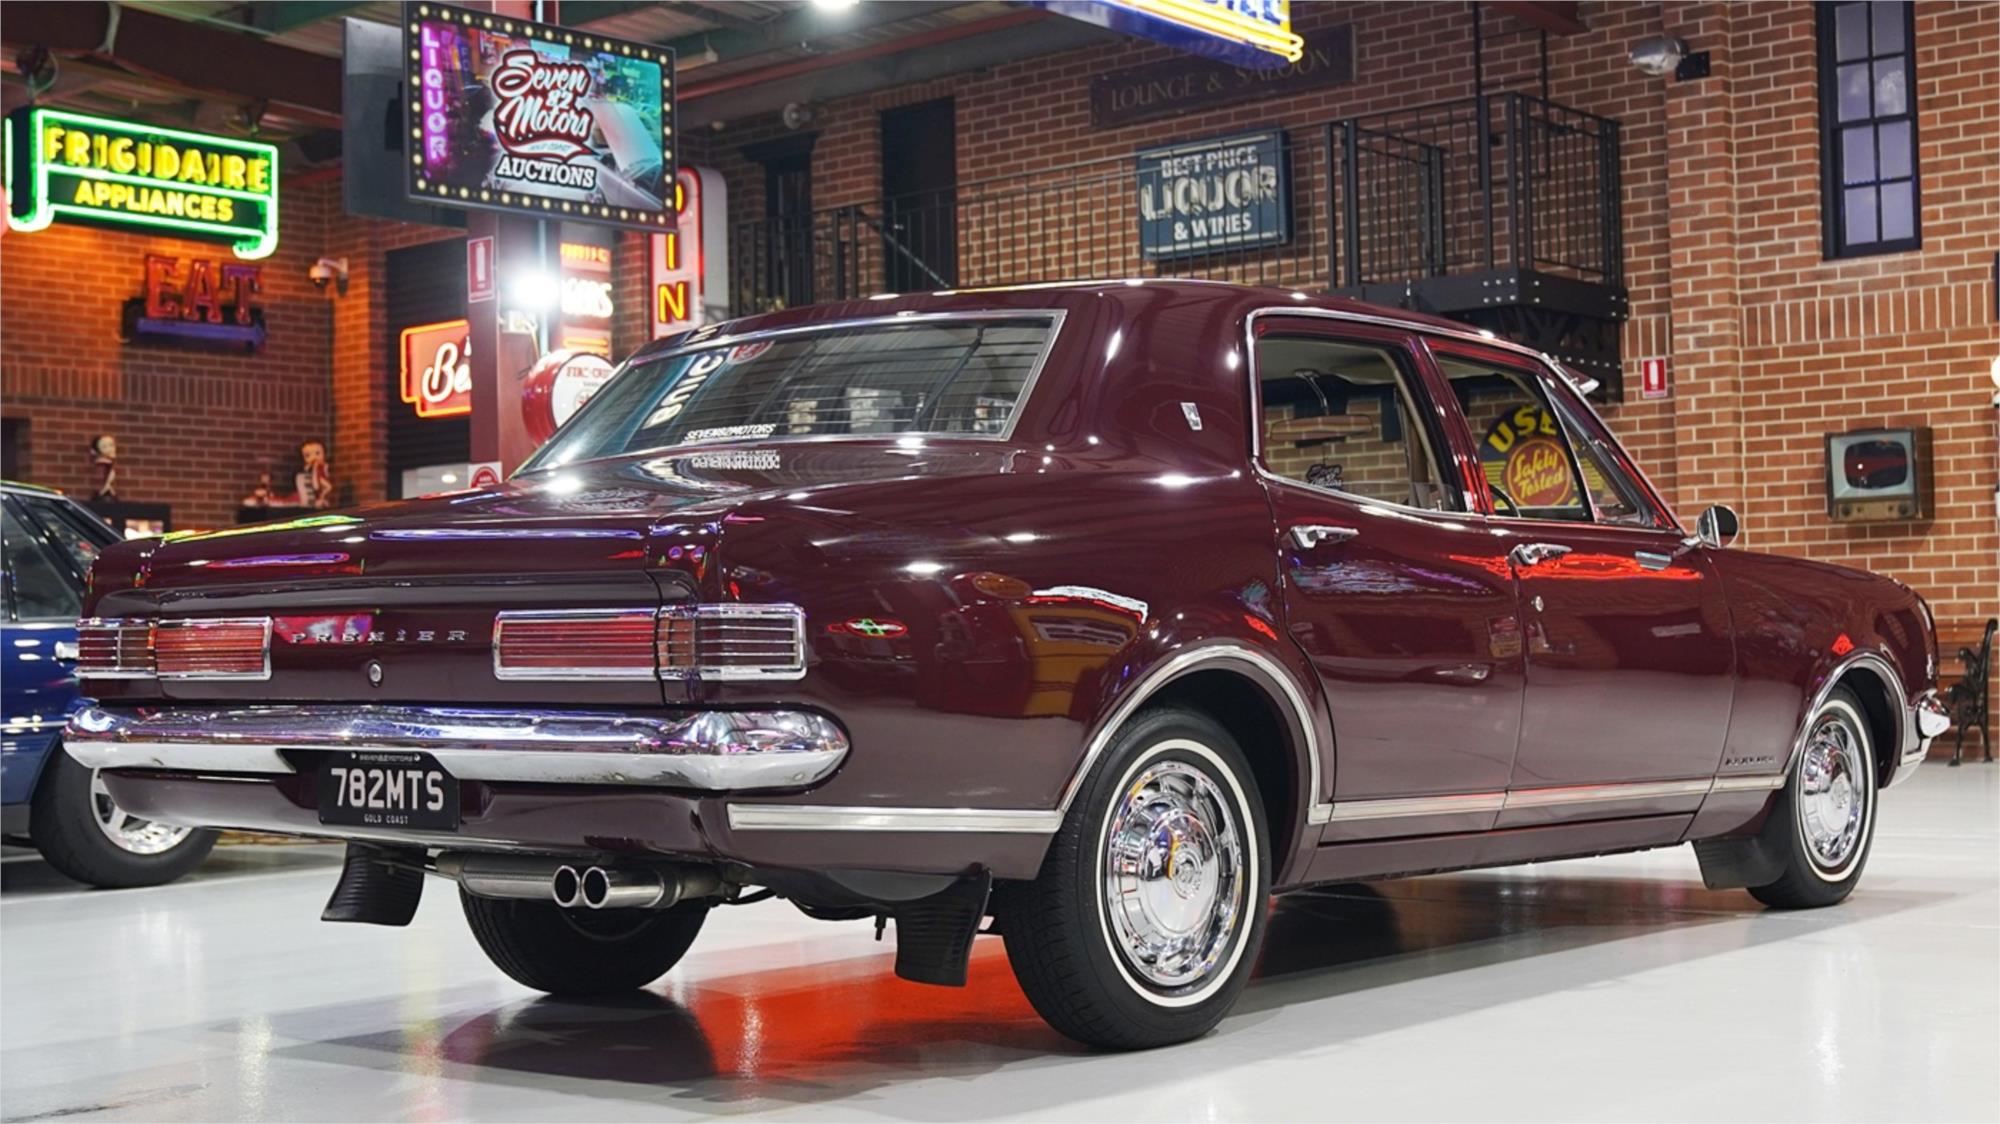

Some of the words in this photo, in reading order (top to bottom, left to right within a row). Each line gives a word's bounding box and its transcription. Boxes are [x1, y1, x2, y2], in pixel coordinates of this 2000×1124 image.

[422, 26, 448, 160] LIQUOR
[497, 53, 589, 97] Seven
[1110, 74, 1197, 112] LOUNGE
[1207, 73, 1224, 93] &
[498, 97, 590, 138] Motors
[546, 91, 572, 109] 82
[43, 126, 269, 192] FRIGIDAIRE
[497, 157, 595, 188] AUCTIONS
[1161, 154, 1202, 179] BEST
[1206, 146, 1258, 171] PRICE
[74, 181, 233, 221] APPLIANCES
[1141, 165, 1277, 221] LIQUOR
[1174, 222, 1188, 241] &
[1191, 213, 1252, 238] WINES
[144, 253, 261, 323] EAT
[1514, 449, 1558, 483] Safety
[1518, 466, 1564, 498] Tested
[331, 768, 444, 811] 782MTS
[364, 814, 382, 823] GOLD
[386, 815, 408, 825] COAST
